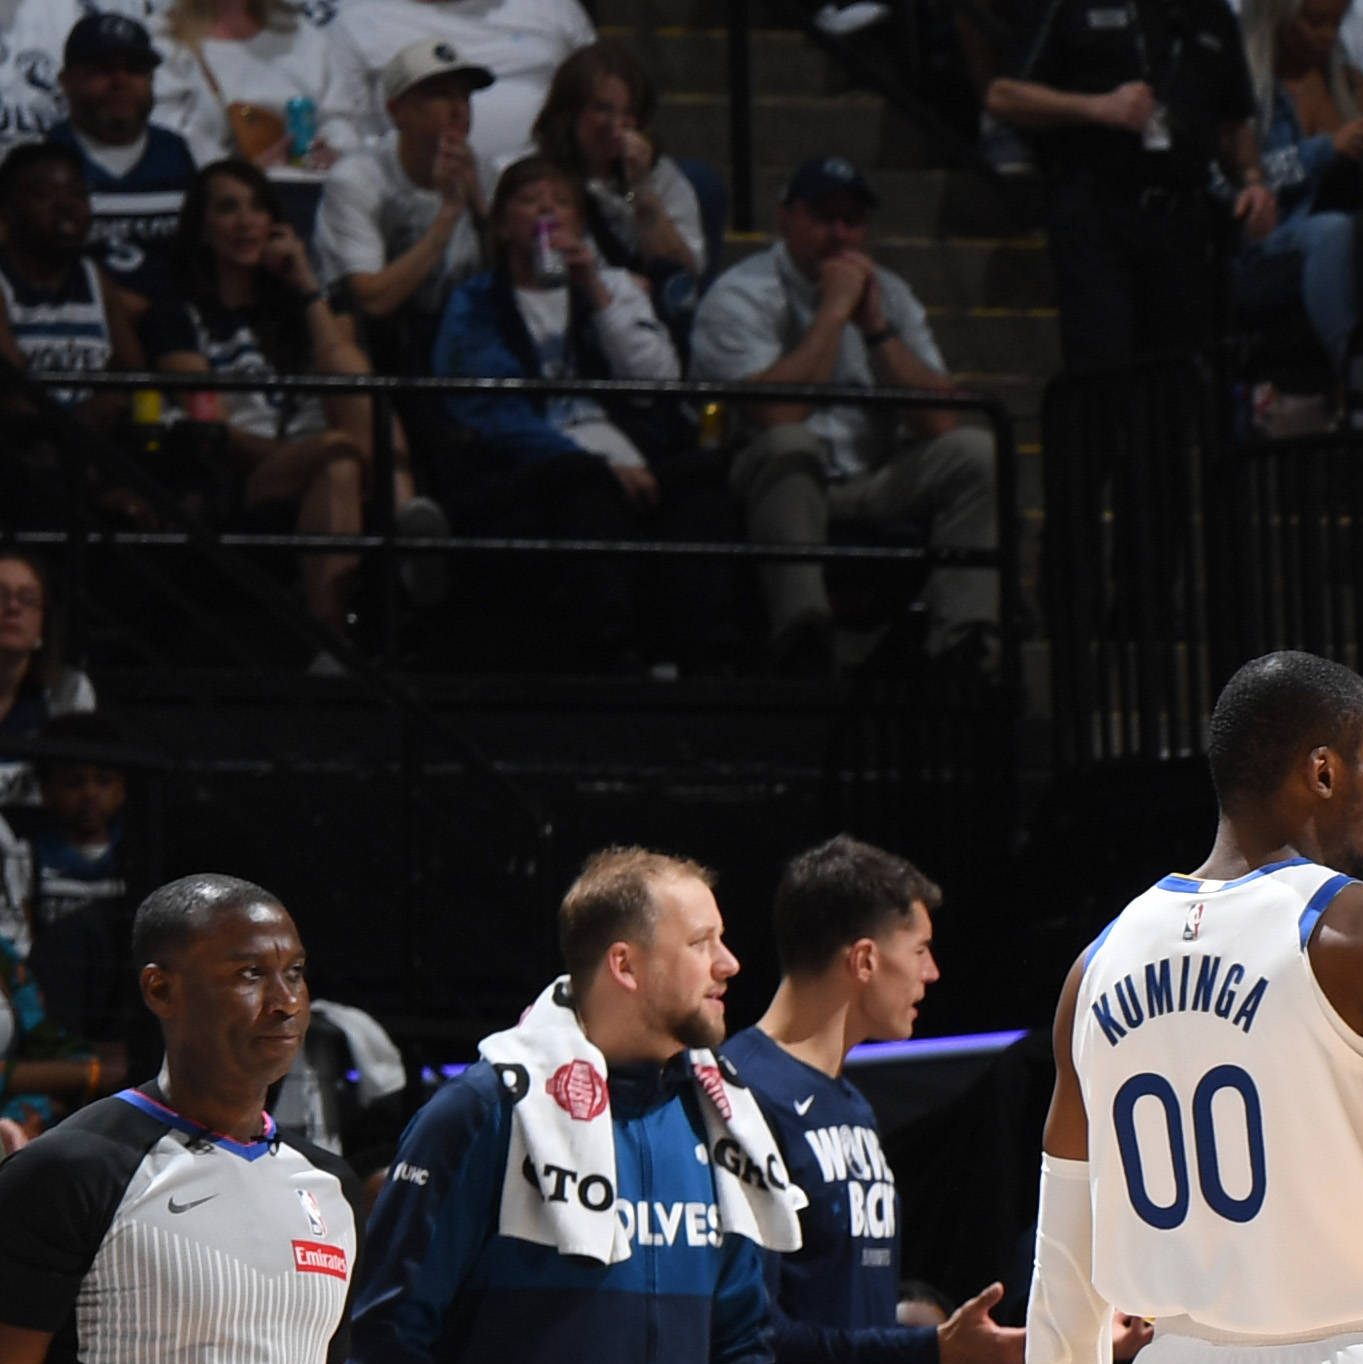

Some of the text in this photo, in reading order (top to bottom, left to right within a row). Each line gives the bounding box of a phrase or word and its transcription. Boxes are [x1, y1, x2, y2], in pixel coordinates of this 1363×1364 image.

[1092, 955, 1269, 1047] KUMINGA
[1112, 1063, 1267, 1231] 00
[614, 1199, 722, 1248] OLVES
[294, 1246, 347, 1274] Emirates
